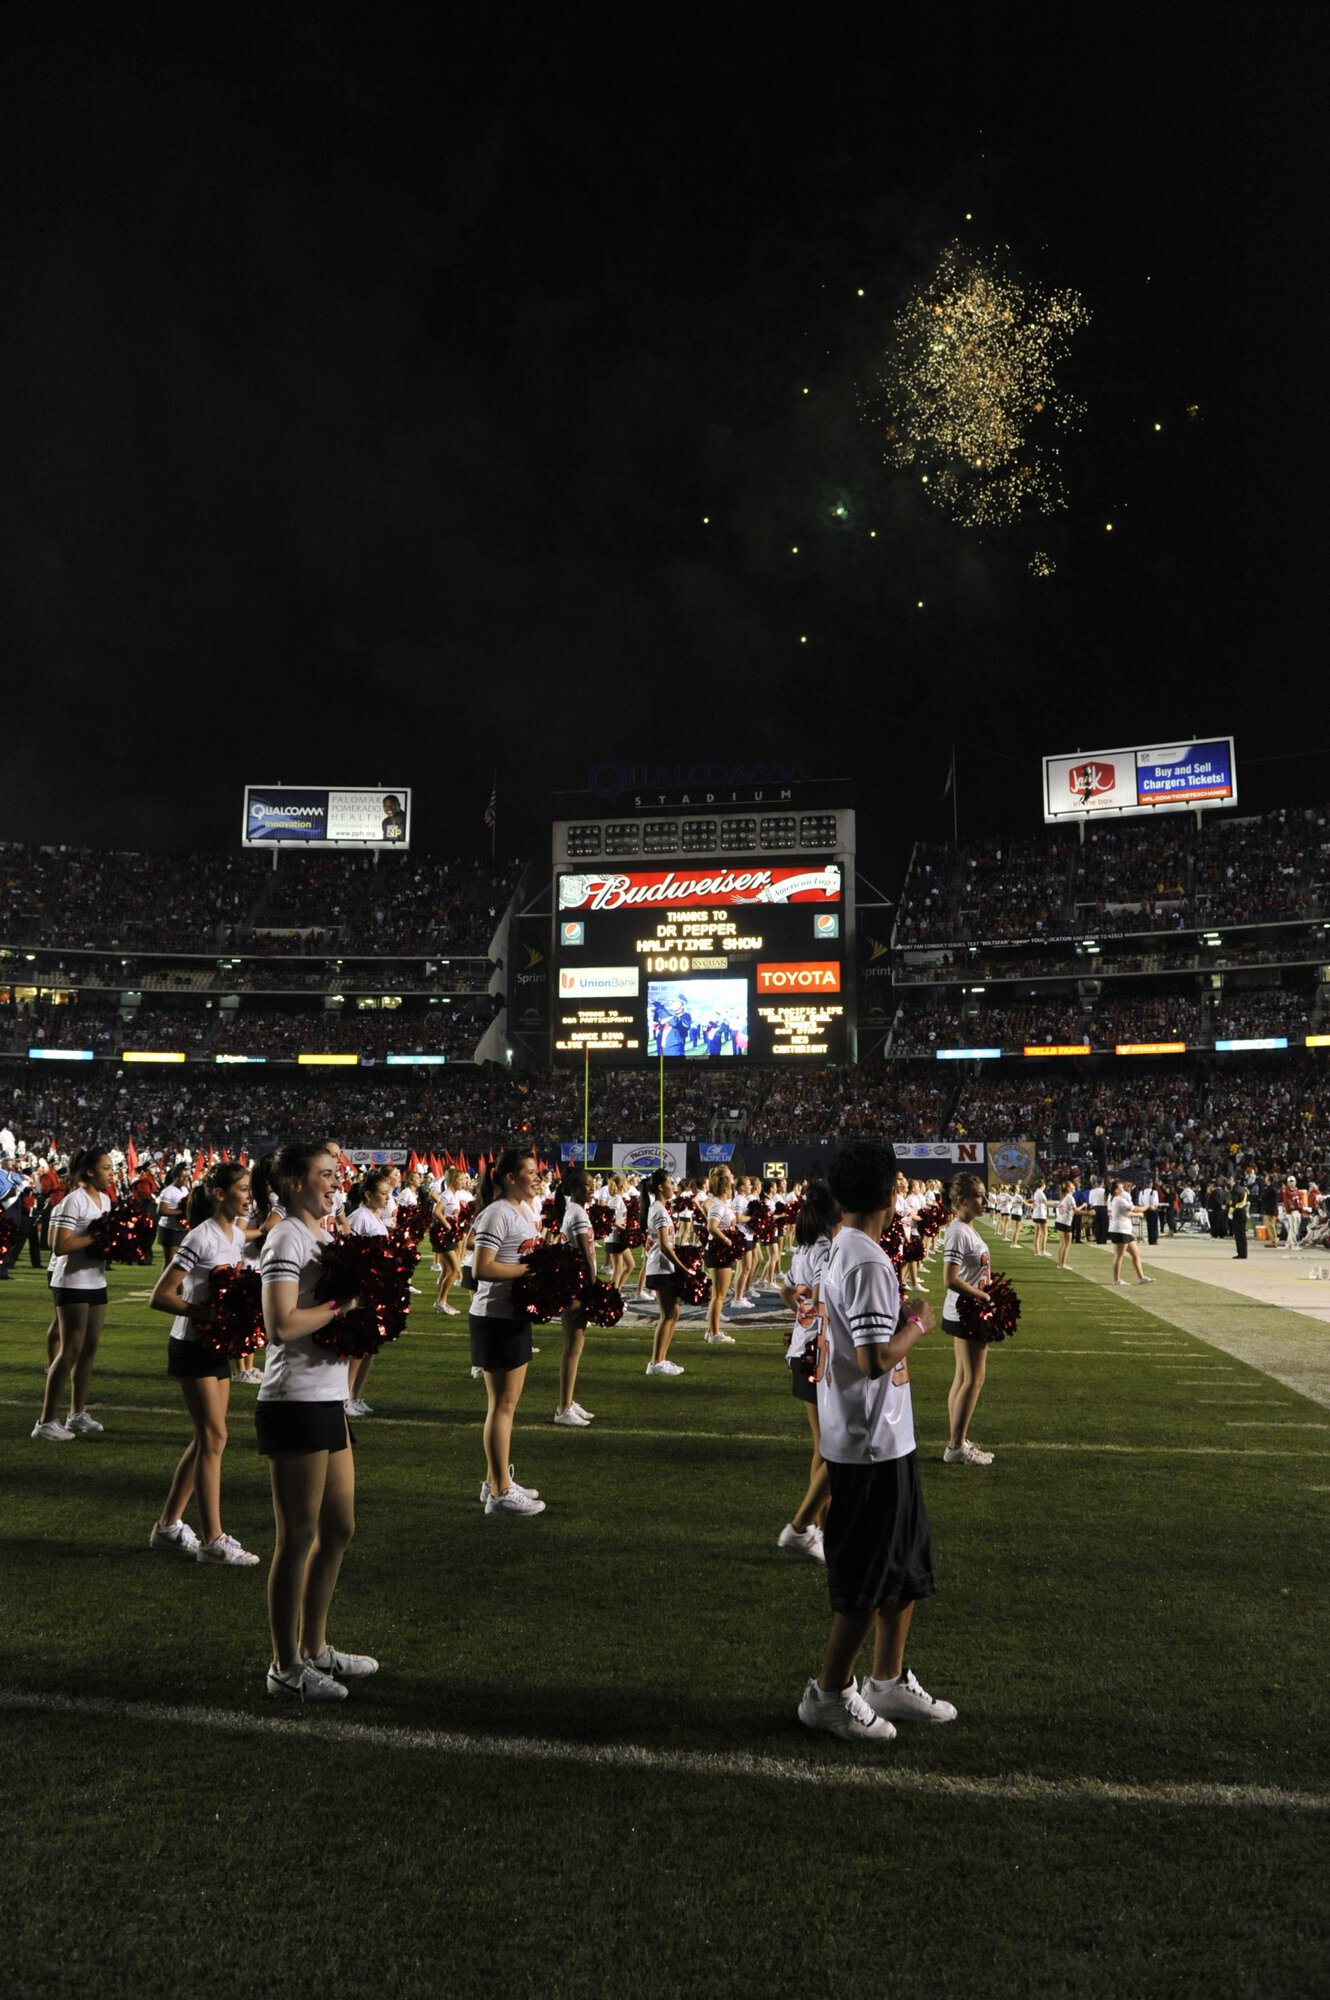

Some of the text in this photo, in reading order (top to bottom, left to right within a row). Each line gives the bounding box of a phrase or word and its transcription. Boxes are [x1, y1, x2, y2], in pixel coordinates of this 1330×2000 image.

[1155, 762, 1212, 778] Buy and Sell
[1143, 773, 1225, 790] Chargers Tickets!
[332, 796, 382, 804] PALOMAR
[635, 790, 792, 807] STADIUM
[1098, 797, 1113, 805] box
[252, 804, 324, 820] QUALCOMM
[332, 805, 382, 813] POMERADO
[585, 869, 772, 911] Budweiser
[774, 879, 812, 897] American
[667, 910, 728, 922] THANKS TO
[656, 923, 737, 937] DR PEPPER
[636, 937, 763, 952] HALFTIME SHOW
[646, 957, 689, 973] 10:00
[580, 978, 637, 988] UnionBank
[761, 970, 837, 987] TOYOTA
[1026, 1046, 1089, 1056] WELLS FARGO
[630, 1149, 655, 1160] PACIFIC
[958, 1144, 977, 1162] N
[766, 1162, 785, 1178] 25
